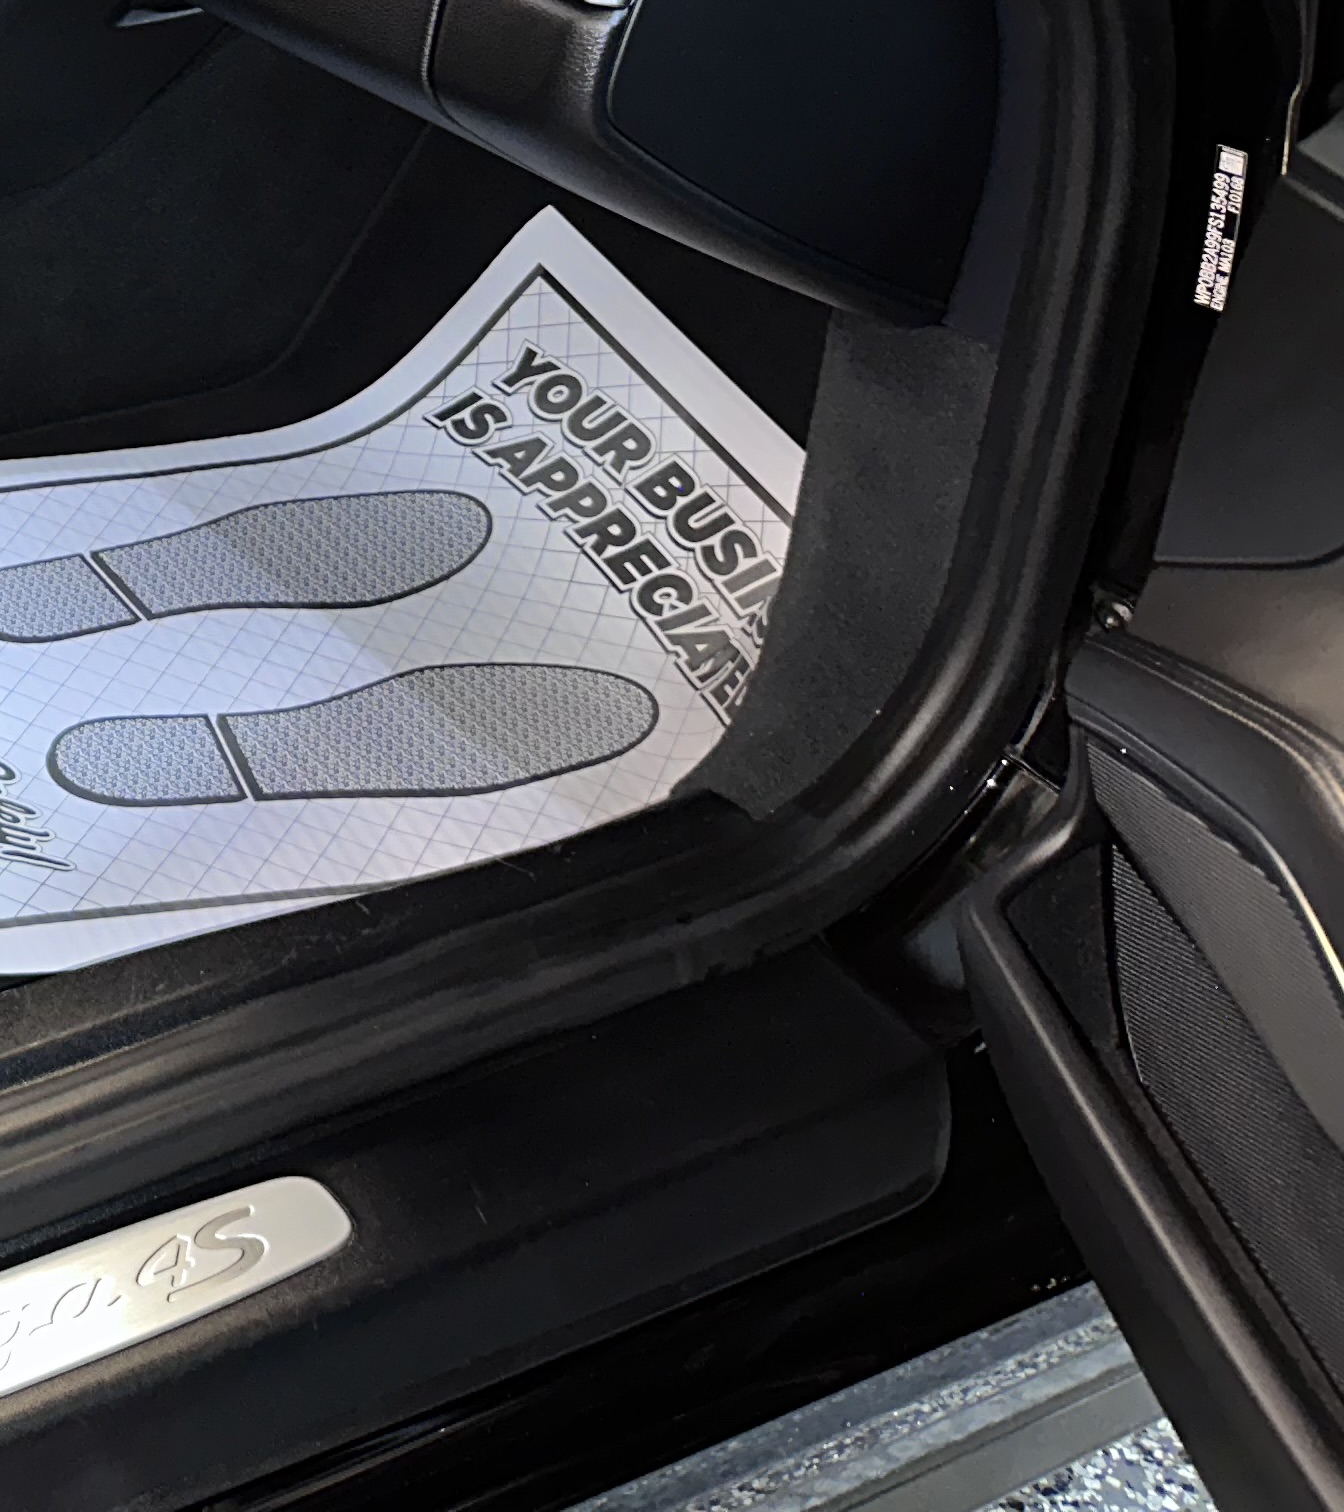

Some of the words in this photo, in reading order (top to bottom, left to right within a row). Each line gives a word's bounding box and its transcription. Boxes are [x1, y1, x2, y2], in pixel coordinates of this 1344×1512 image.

[426, 388, 511, 444] IS
[495, 342, 654, 483] YOUR
[135, 1204, 271, 1304] 4S
